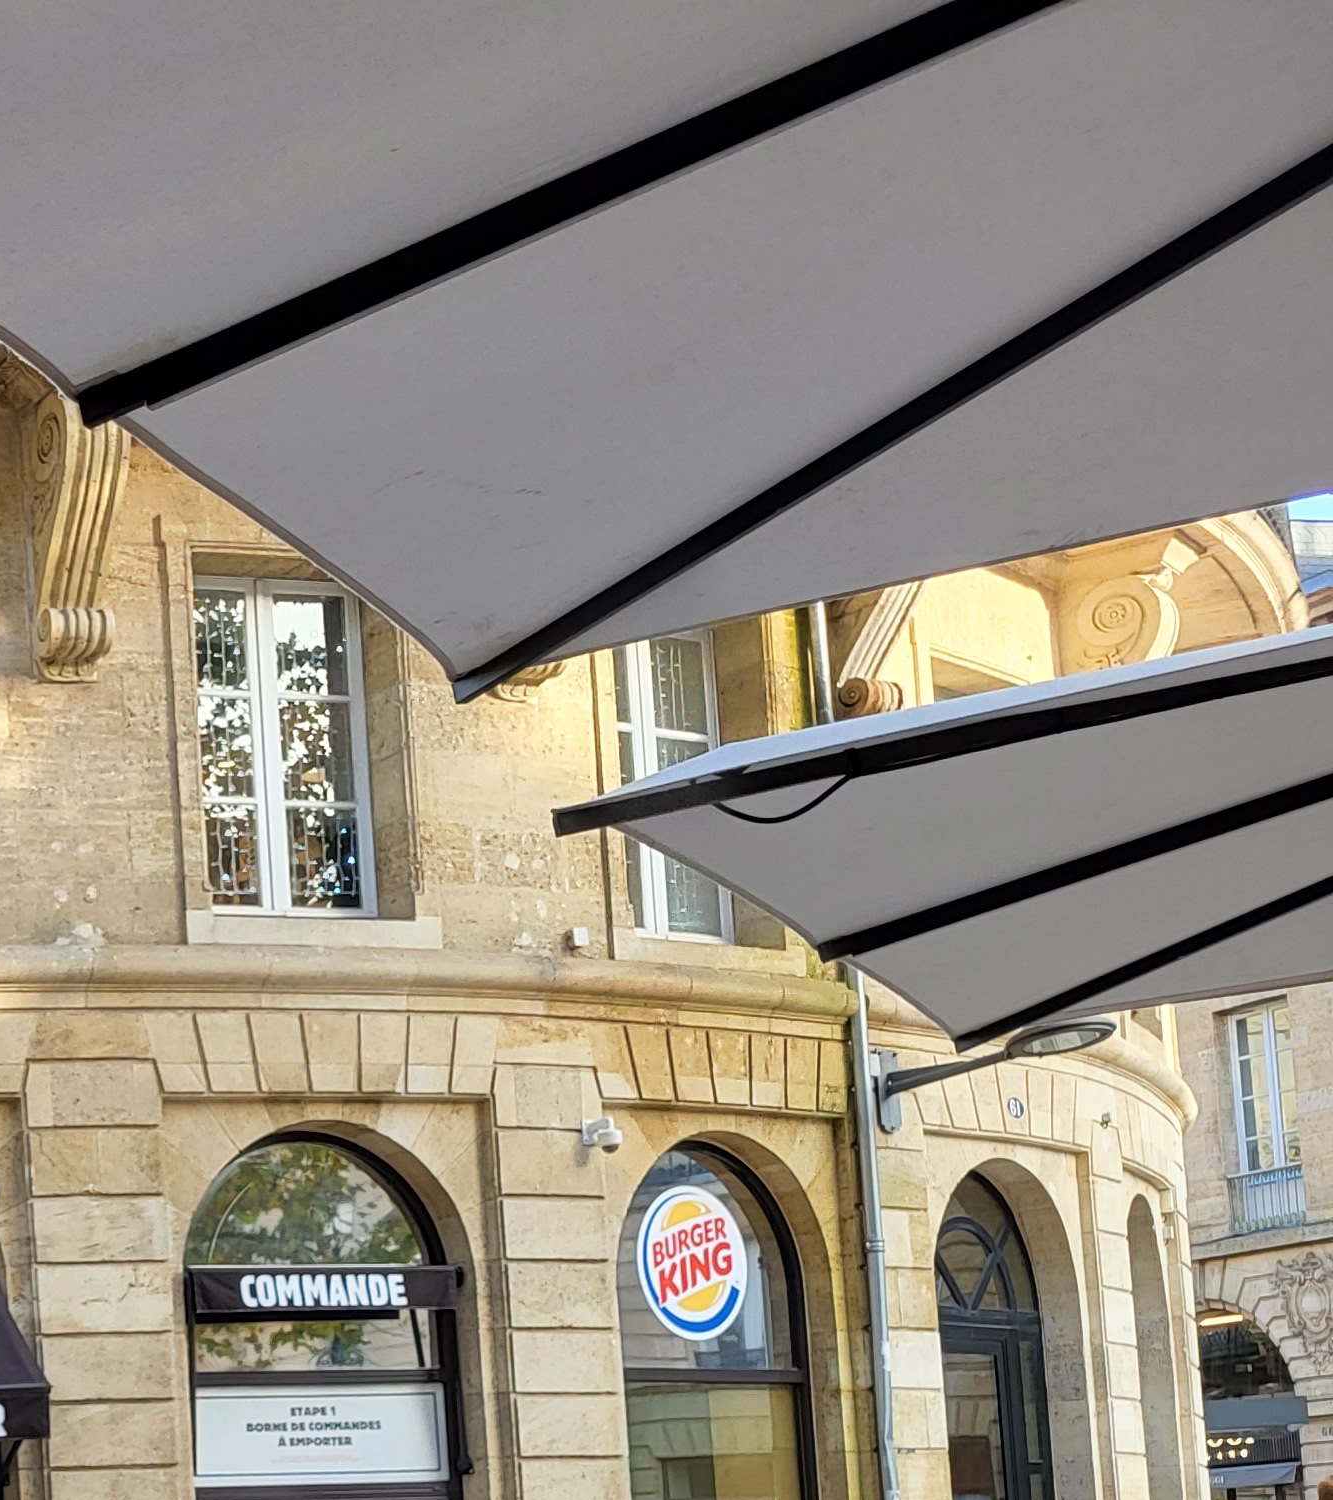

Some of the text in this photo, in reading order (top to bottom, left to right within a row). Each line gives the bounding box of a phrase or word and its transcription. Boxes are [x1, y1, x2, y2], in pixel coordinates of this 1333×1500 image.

[1010, 1098, 1021, 1117] 61
[652, 1217, 727, 1269] BURGER
[659, 1242, 732, 1305] KING
[240, 1273, 408, 1308] COMMANDE
[290, 1406, 336, 1417] ETAPE 1
[246, 1420, 382, 1432] BORNE DE COMMANDES
[289, 1436, 353, 1447] EMPORTER
